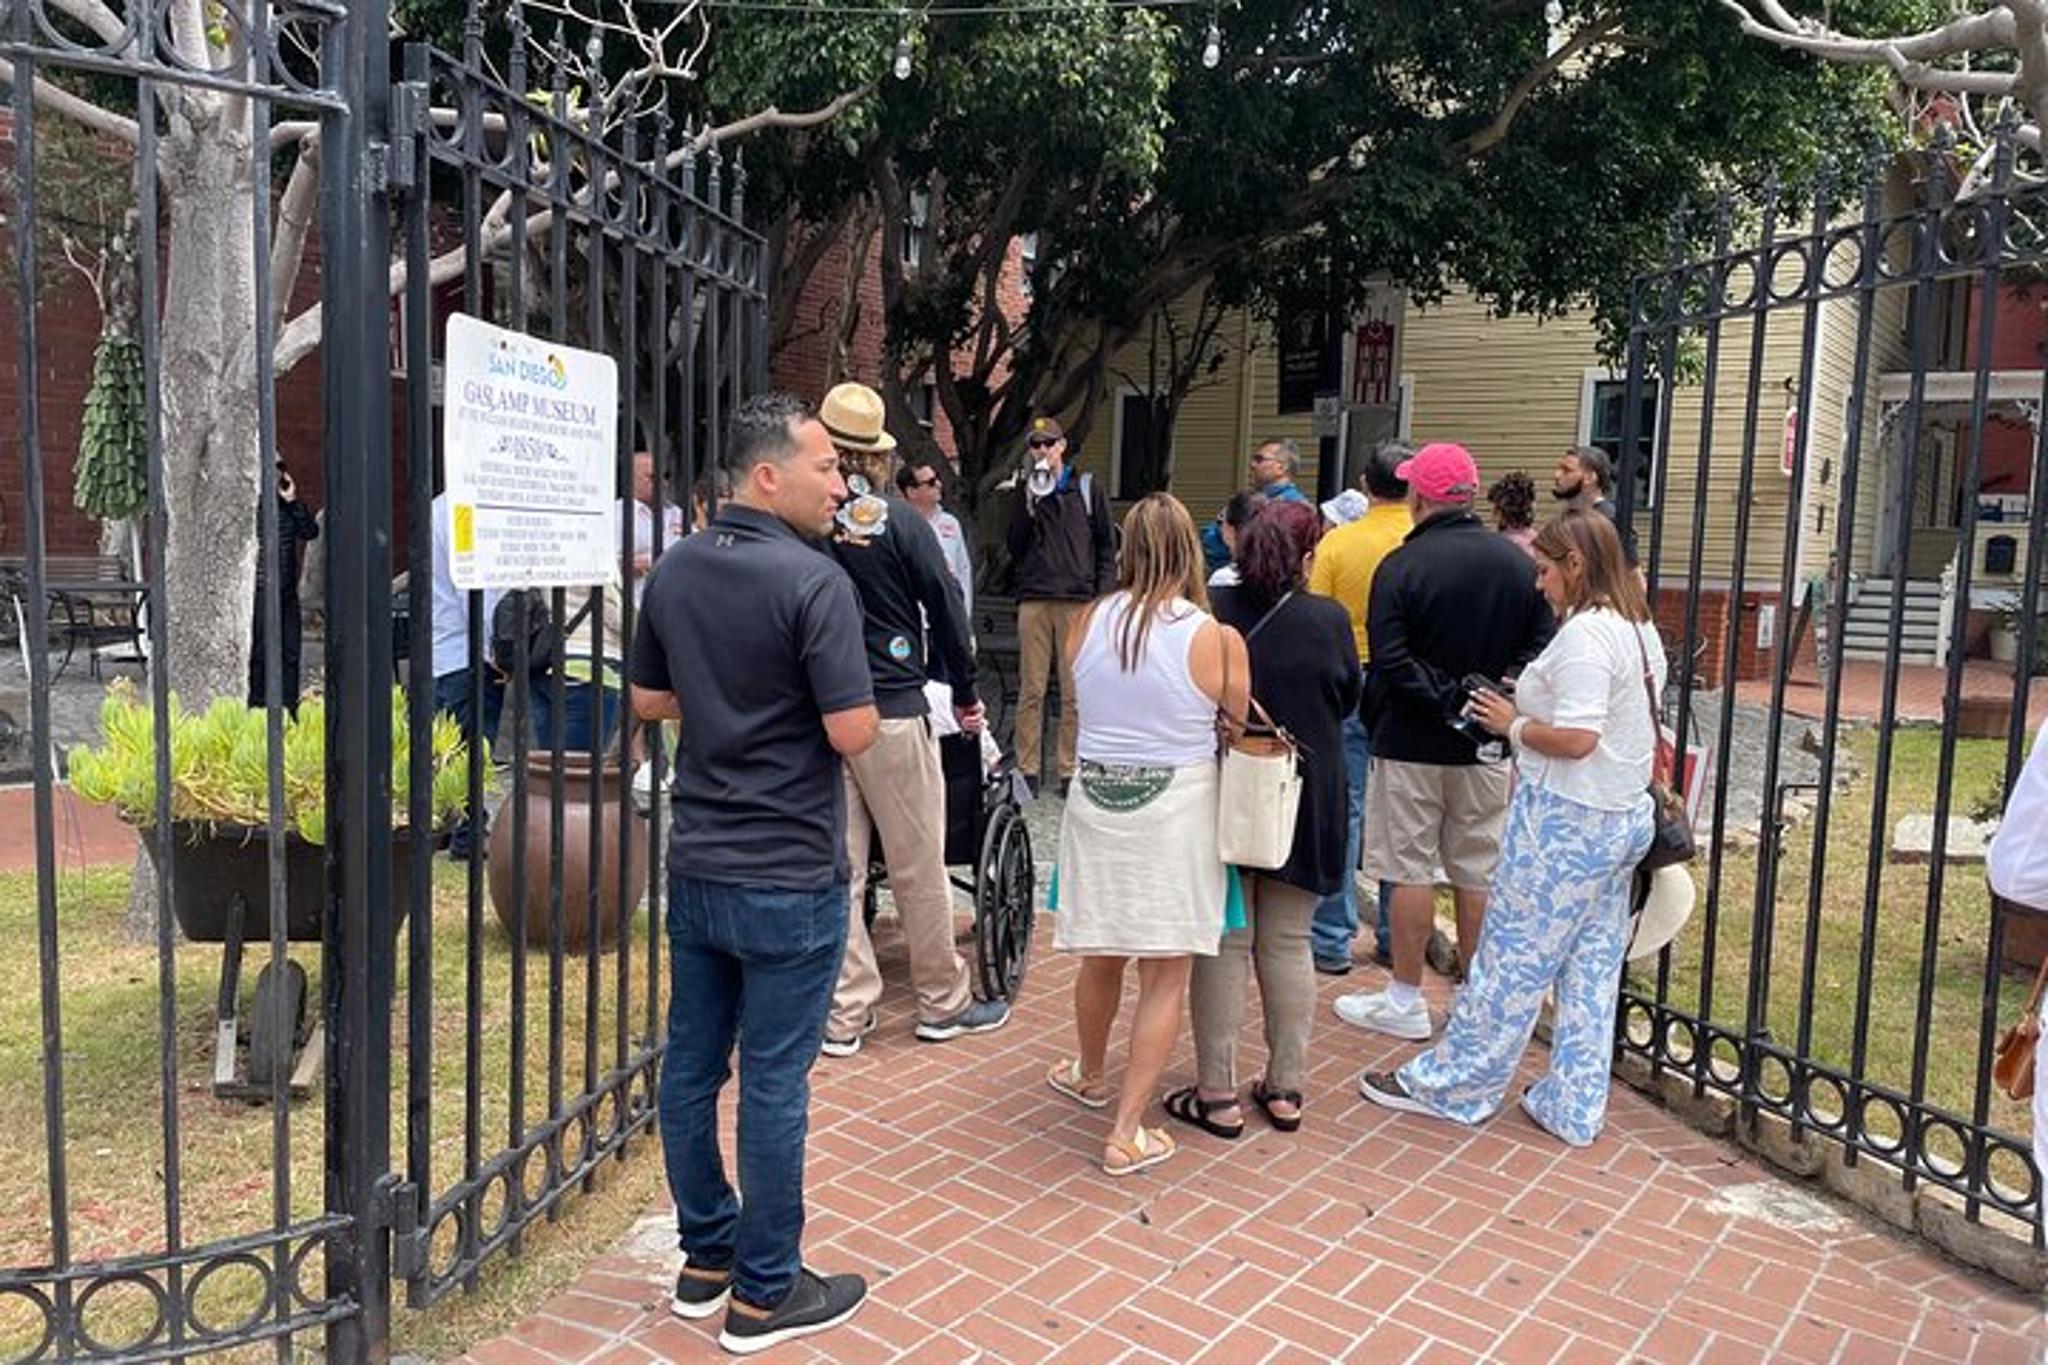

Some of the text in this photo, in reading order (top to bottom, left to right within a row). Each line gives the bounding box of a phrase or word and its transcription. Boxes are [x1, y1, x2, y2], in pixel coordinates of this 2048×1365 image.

[489, 353, 558, 388] SAN DIEGO
[463, 380, 529, 414] GASLAMP
[533, 395, 596, 426] MUSEUM
